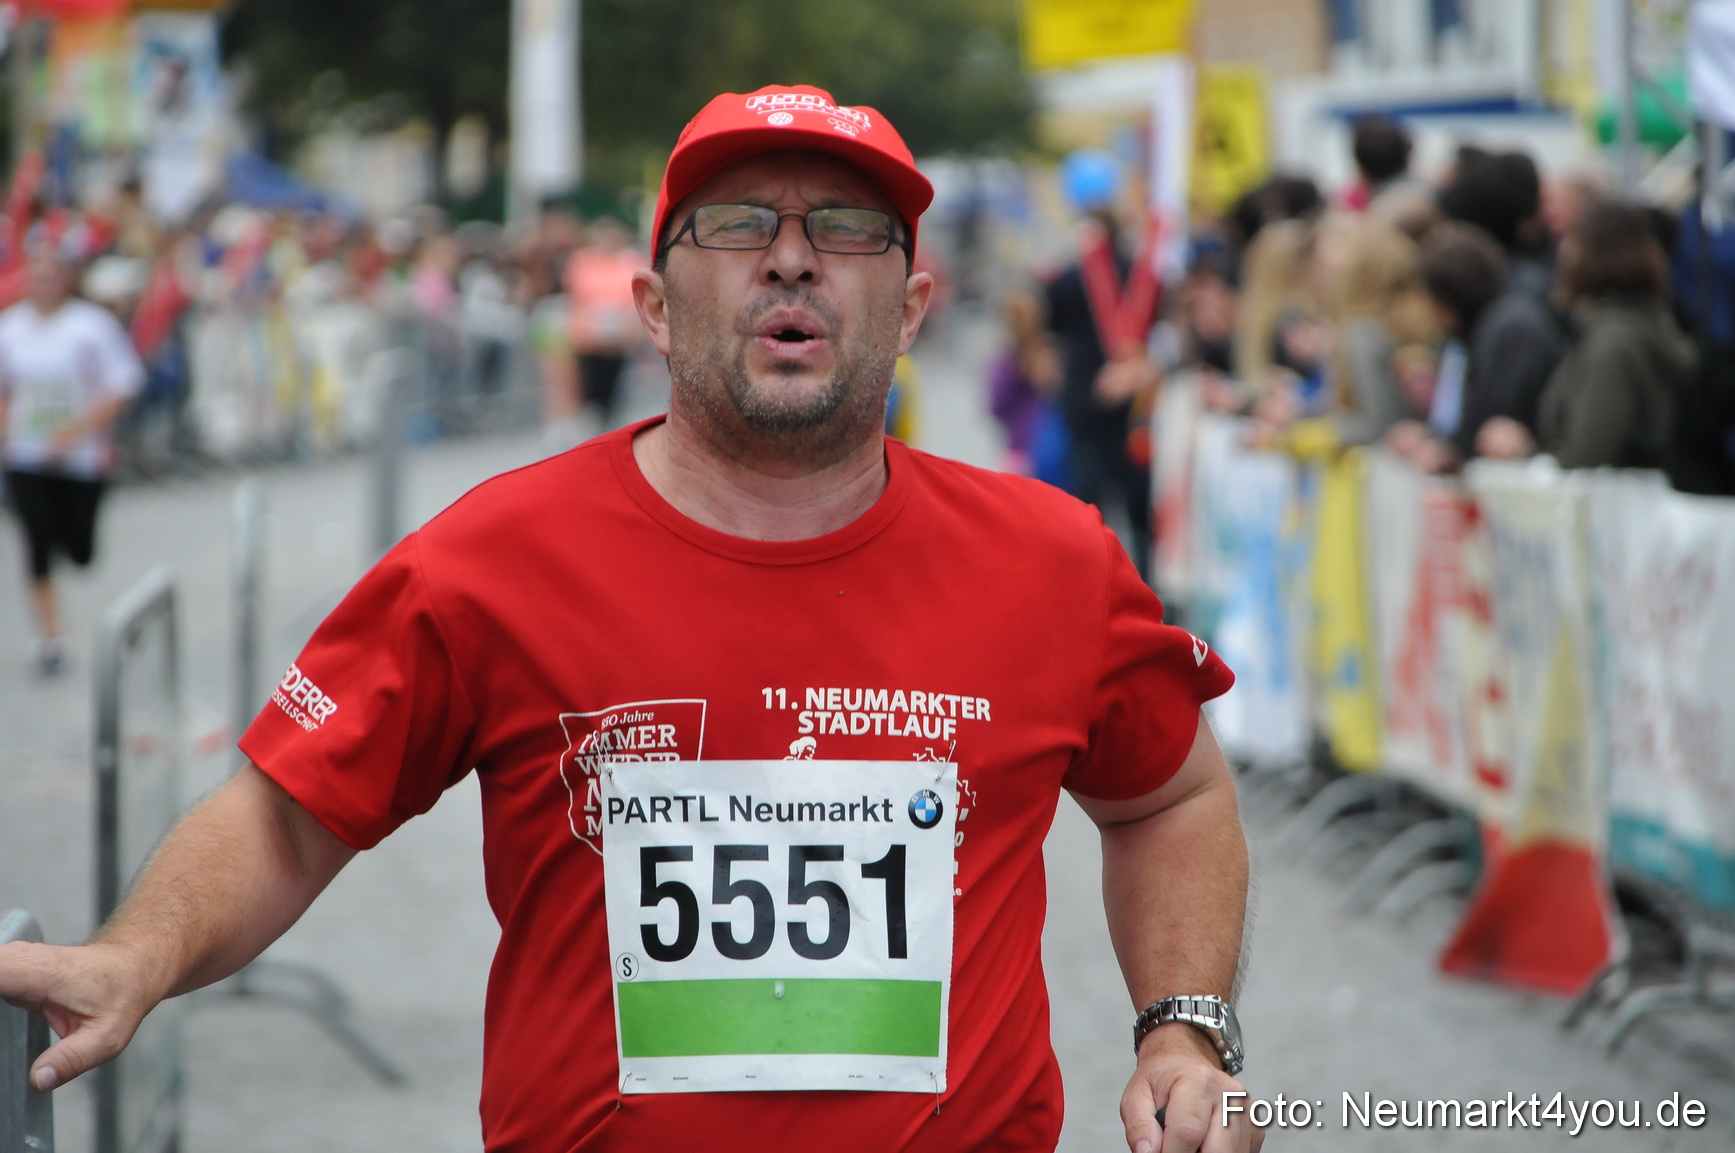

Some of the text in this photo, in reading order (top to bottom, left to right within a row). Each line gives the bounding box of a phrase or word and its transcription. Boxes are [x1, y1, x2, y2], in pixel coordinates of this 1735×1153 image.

[620, 709, 655, 725] Jahre
[761, 687, 991, 722] 11. NEUMARKTER
[577, 723, 678, 755] IMMER
[798, 710, 957, 742] STADTLAUF
[608, 795, 894, 825] PARTL Neumarkt
[639, 844, 908, 962] 5551
